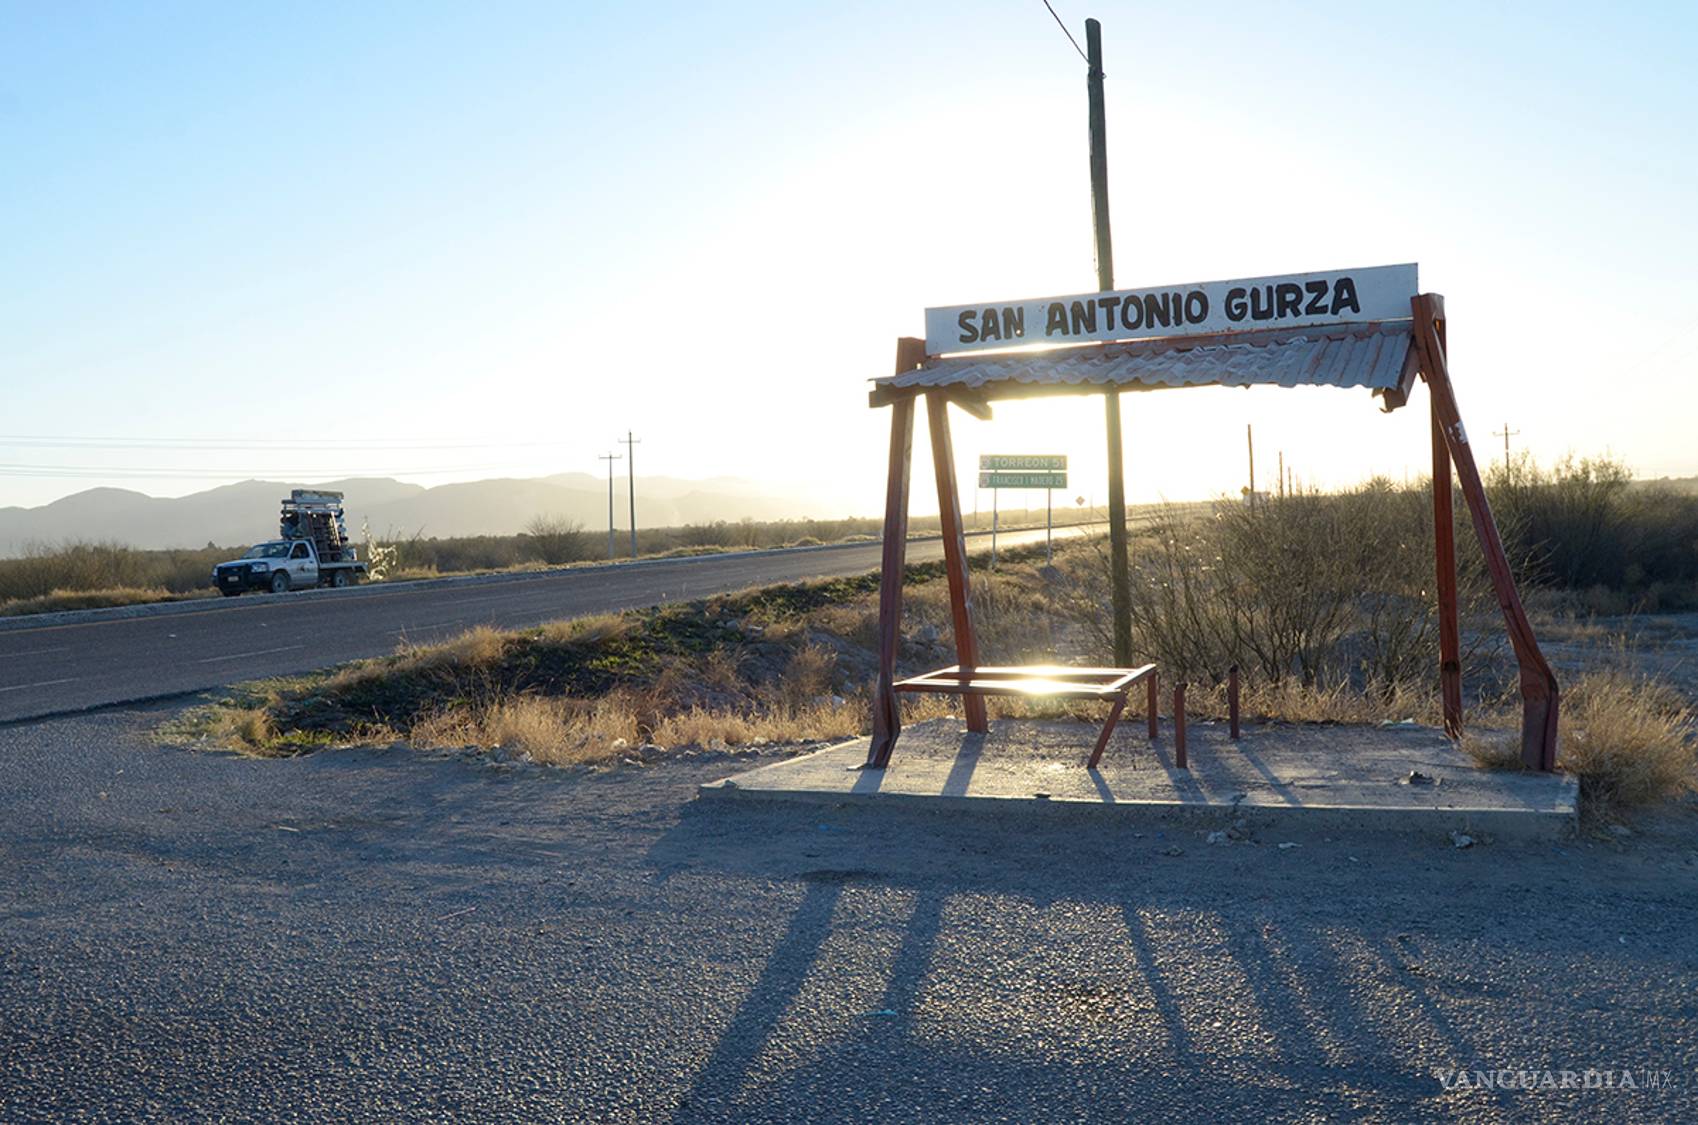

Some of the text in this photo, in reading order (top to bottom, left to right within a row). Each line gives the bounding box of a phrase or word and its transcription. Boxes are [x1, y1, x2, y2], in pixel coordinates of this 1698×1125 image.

[958, 277, 1361, 343] SAN ANTONIO GURZA
